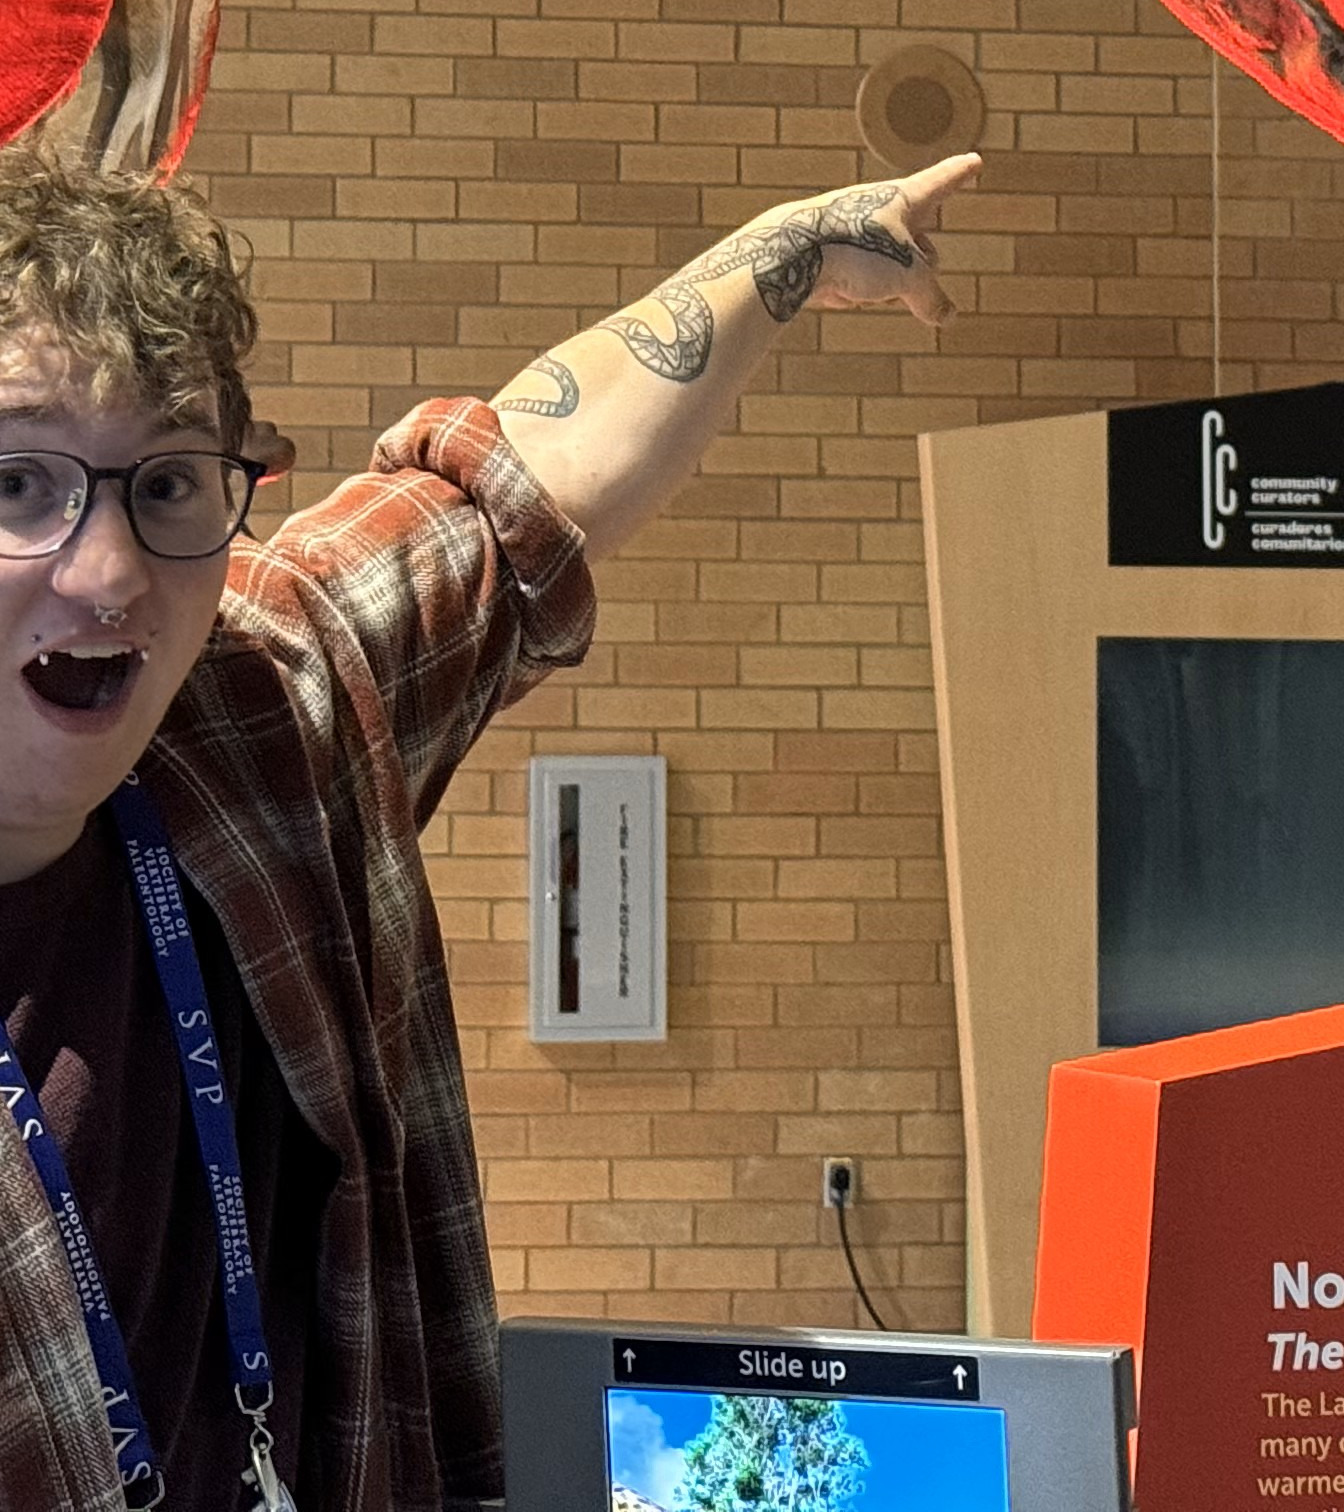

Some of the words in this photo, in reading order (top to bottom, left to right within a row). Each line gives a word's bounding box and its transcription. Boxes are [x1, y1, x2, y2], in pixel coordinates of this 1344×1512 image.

[1250, 477, 1339, 494] community
[1250, 491, 1322, 505] curators
[1250, 521, 1334, 535] curadores
[126, 839, 170, 958] PALEONTOLOGY
[143, 848, 178, 941] VERTEBRATE
[156, 846, 183, 911] SOCIETY
[176, 917, 190, 937] OF
[178, 1010, 223, 1104] SVP
[60, 1191, 111, 1321] PALEONTOLOGY
[209, 1165, 238, 1295] PALEONTOLOGY
[738, 1349, 804, 1378] Slide
[811, 1359, 847, 1387] up
[1261, 1392, 1312, 1417] The
[1260, 1435, 1332, 1462] many
